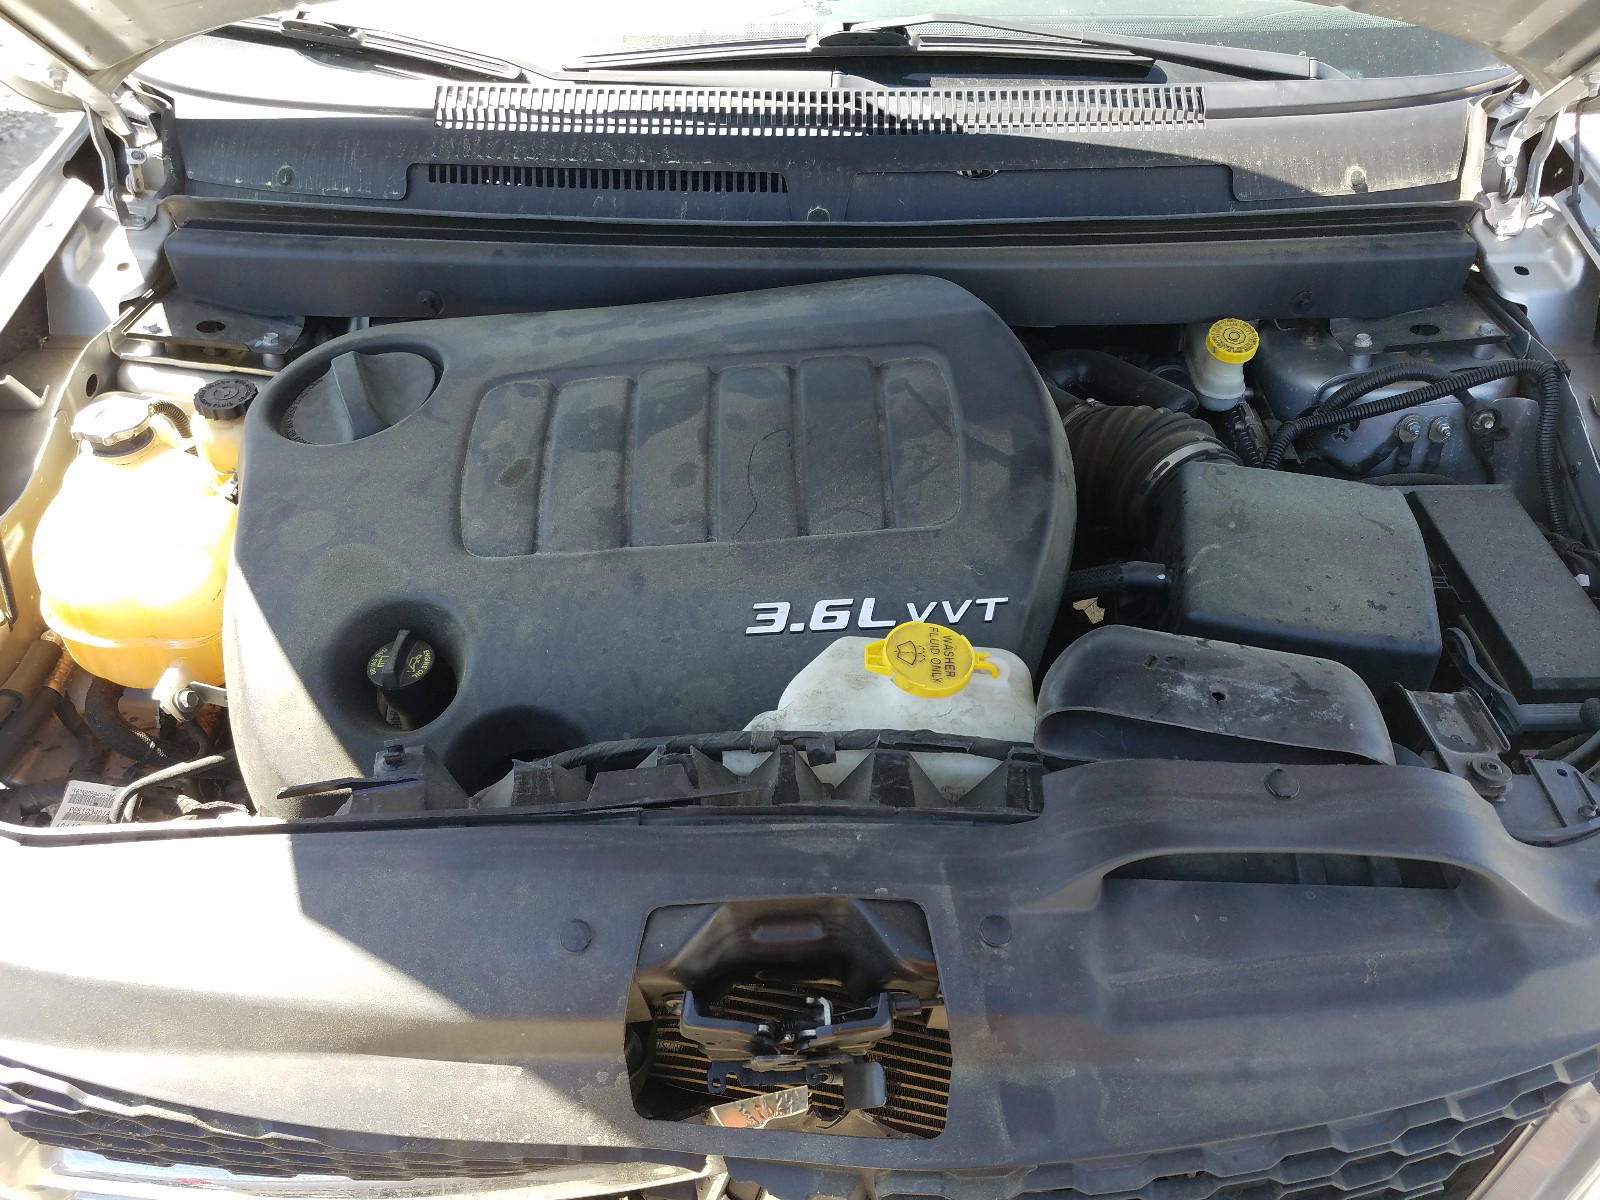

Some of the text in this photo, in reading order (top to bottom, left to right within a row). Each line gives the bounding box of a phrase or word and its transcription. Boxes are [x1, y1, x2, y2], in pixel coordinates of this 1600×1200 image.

[745, 597, 1009, 634] 3.6L VVT
[412, 669, 424, 678] OIL
[928, 626, 943, 685] FLUID ONLY
[942, 635, 956, 678] WASHER
